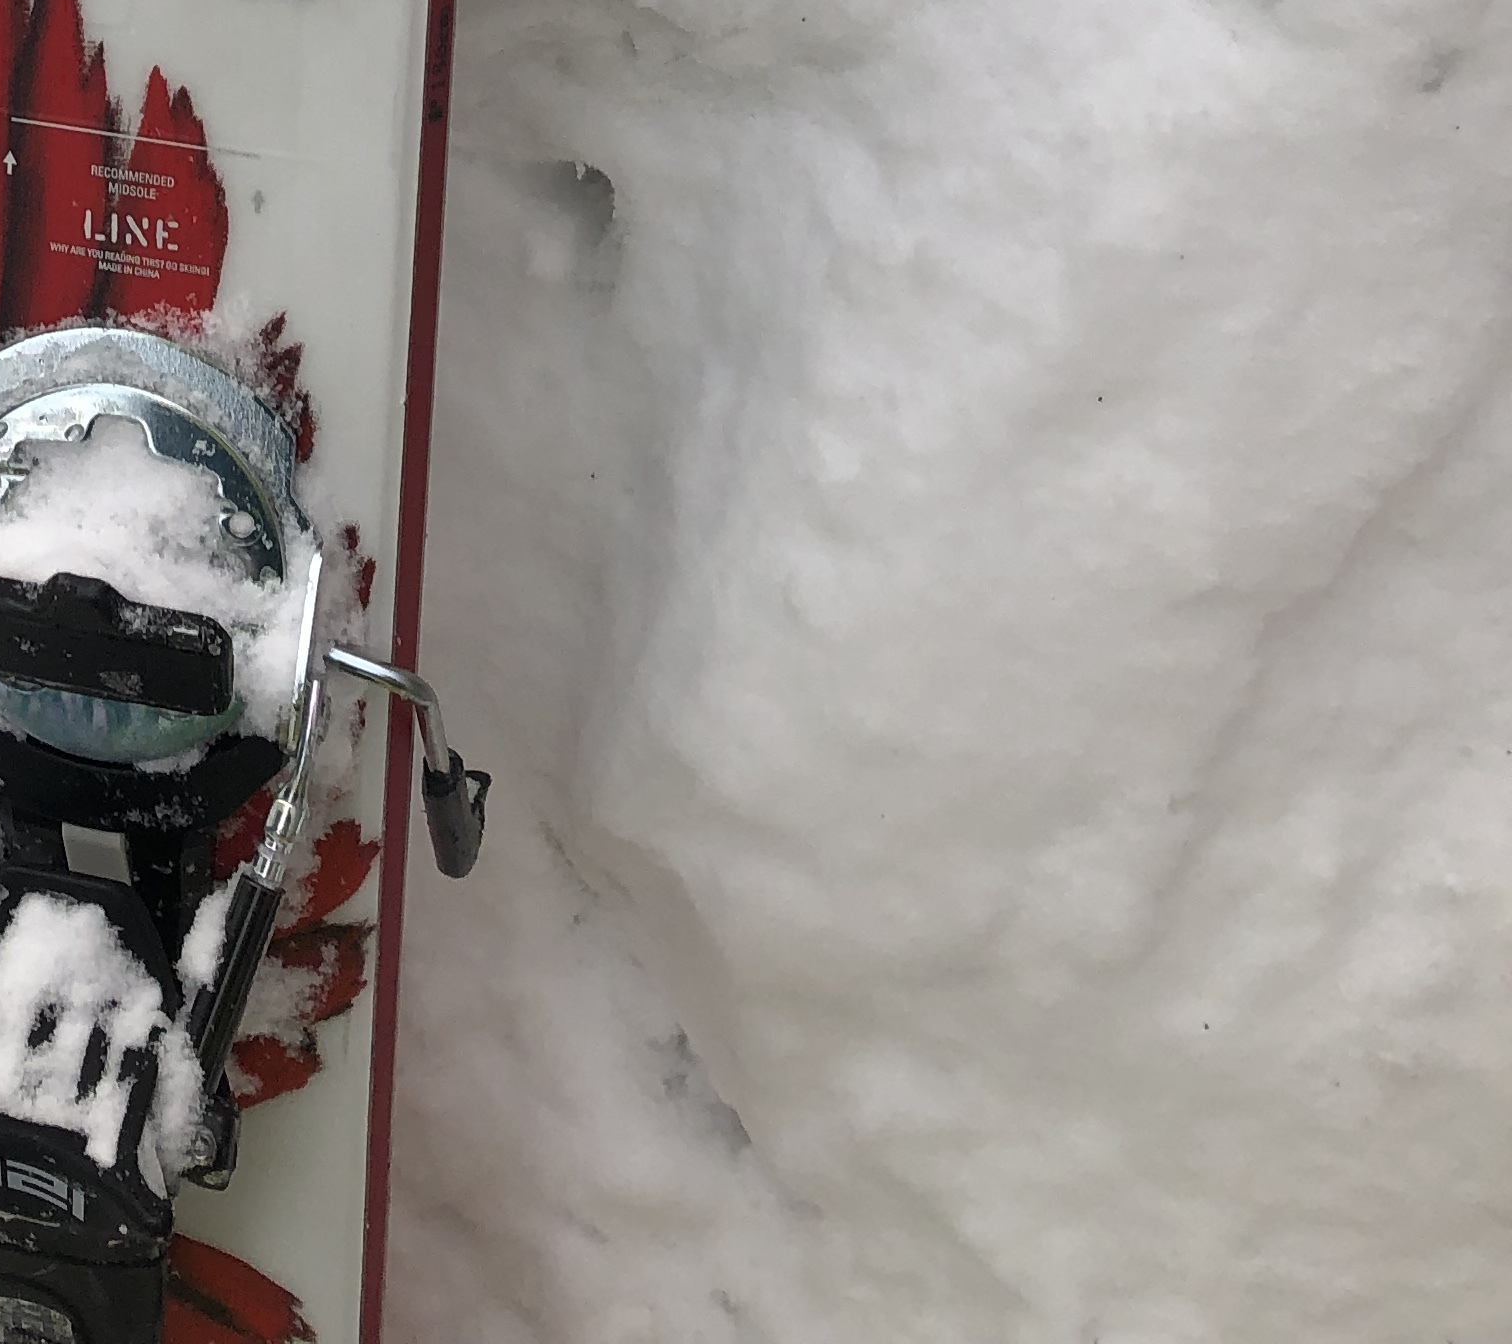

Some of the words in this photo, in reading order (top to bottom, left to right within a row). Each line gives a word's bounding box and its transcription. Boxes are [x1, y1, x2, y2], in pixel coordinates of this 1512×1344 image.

[90, 164, 176, 189] RECOMMENDED
[108, 181, 158, 201] MIDSOLE
[83, 208, 180, 252] LINE
[49, 240, 71, 255] WHY
[70, 243, 87, 258] ARE
[87, 246, 105, 261] YOU
[98, 260, 124, 275] MADE
[124, 265, 134, 276] IN
[134, 266, 161, 280] CHINA
